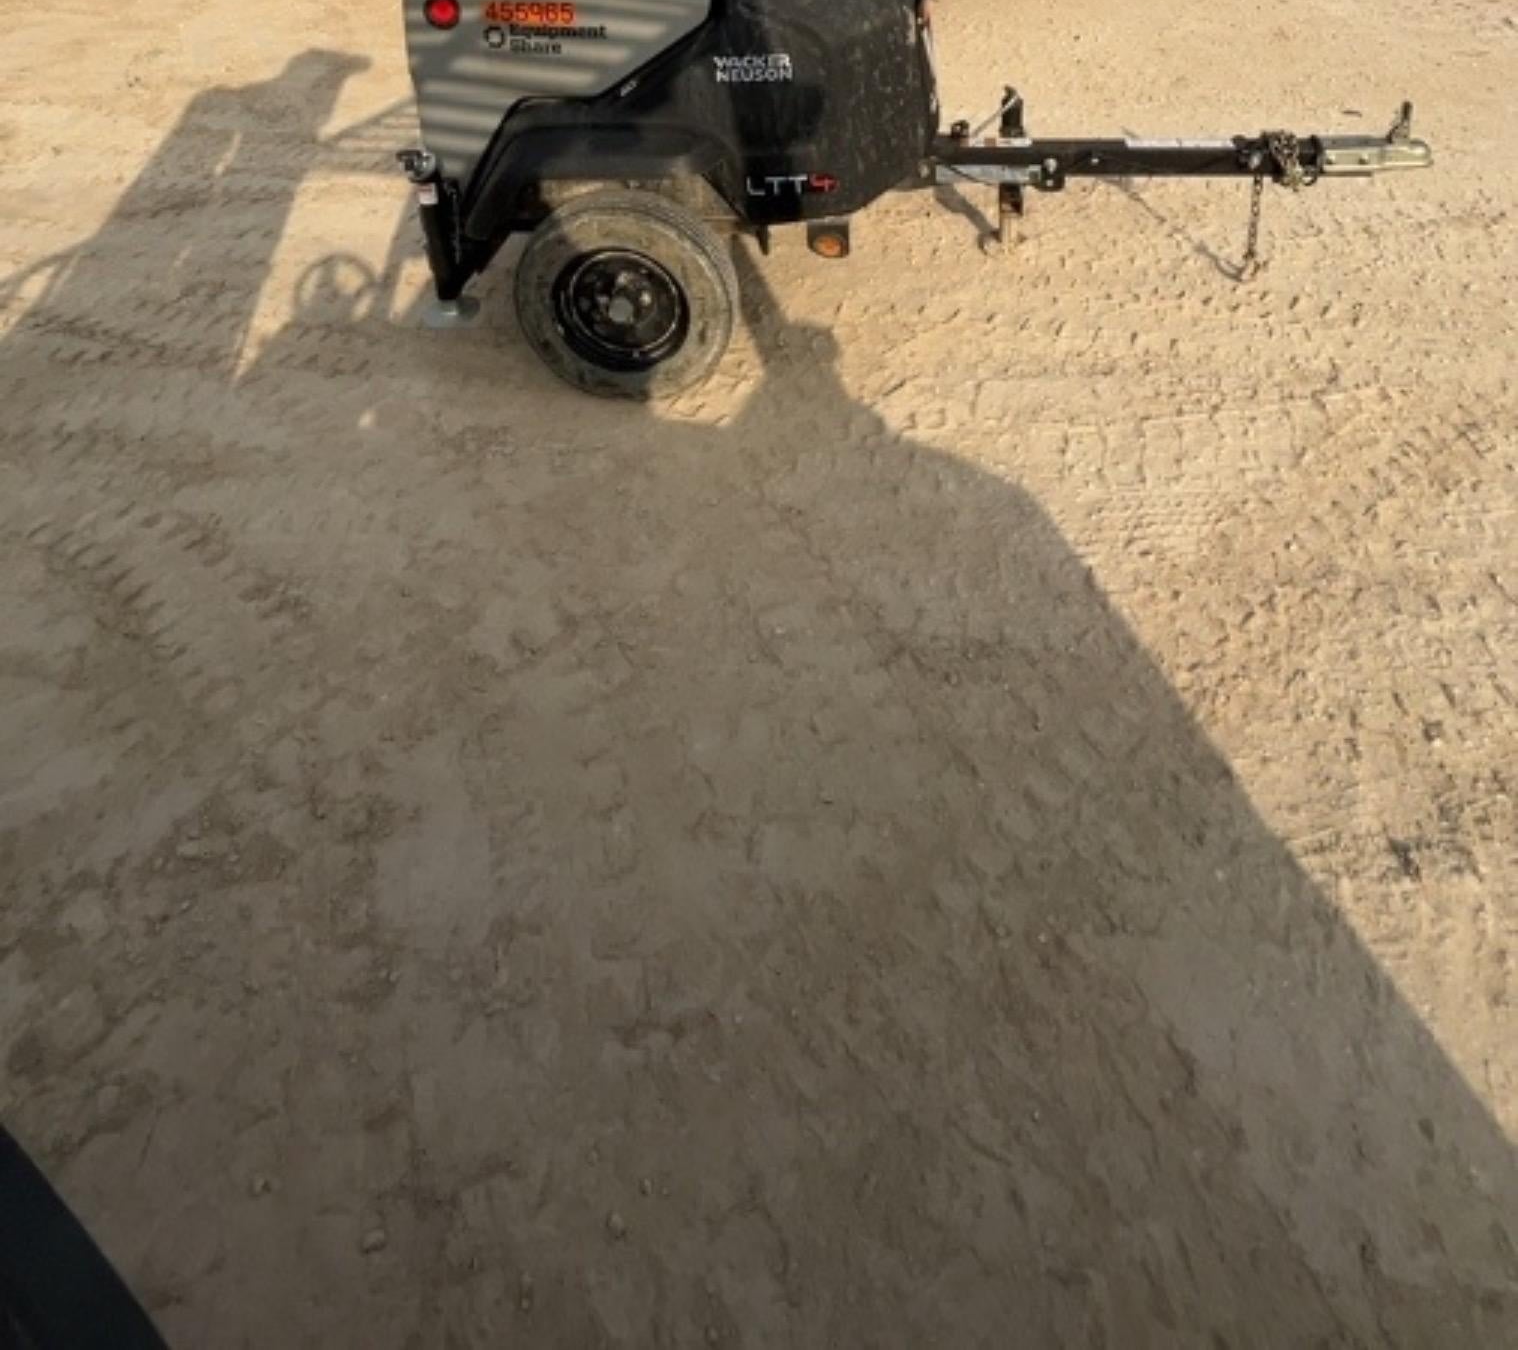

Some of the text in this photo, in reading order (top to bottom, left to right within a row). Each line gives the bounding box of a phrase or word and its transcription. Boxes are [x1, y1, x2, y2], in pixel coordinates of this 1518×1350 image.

[509, 23, 607, 40] Equipment
[509, 38, 562, 55] Share
[713, 53, 791, 68] WACKER
[716, 66, 793, 83] NEUSON
